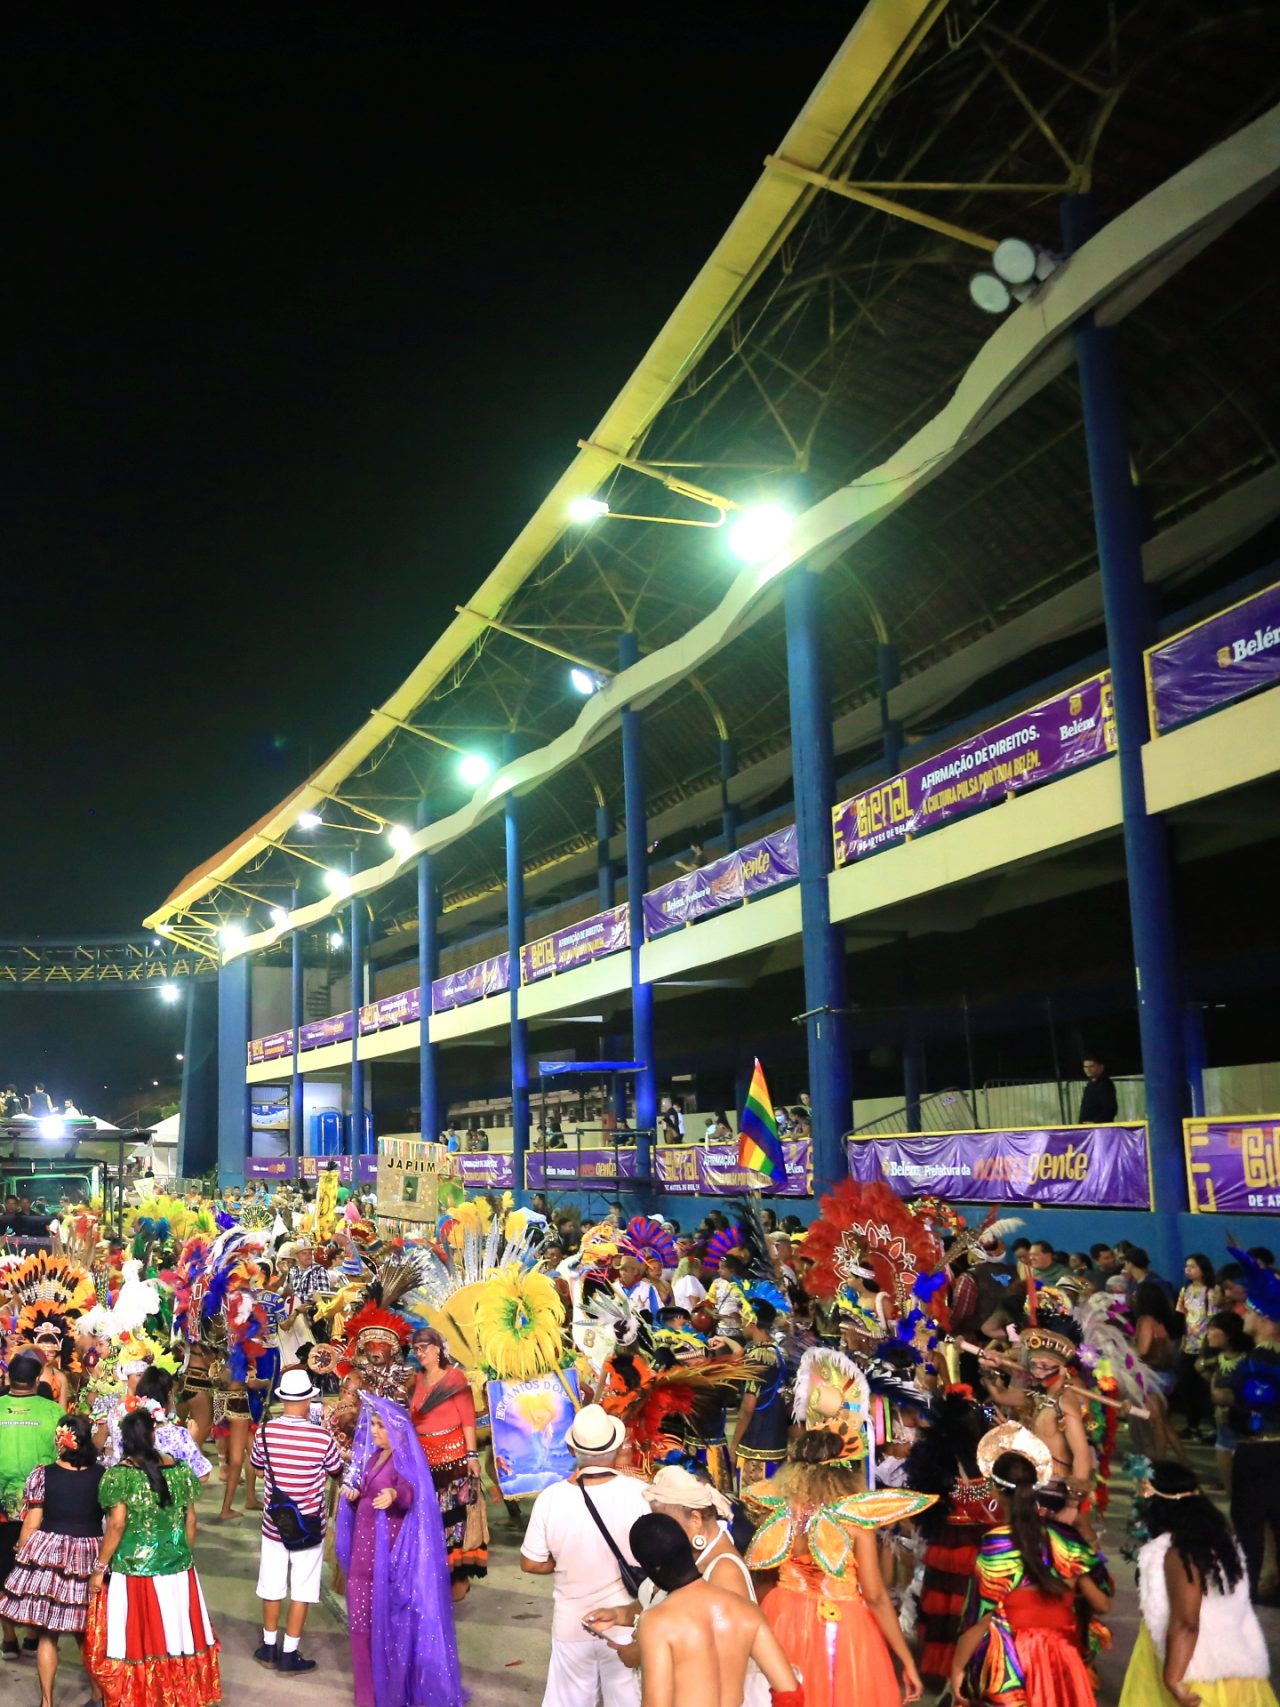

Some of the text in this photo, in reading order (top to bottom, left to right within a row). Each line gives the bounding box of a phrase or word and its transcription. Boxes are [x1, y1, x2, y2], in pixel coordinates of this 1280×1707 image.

[1059, 717, 1096, 740] Belém
[921, 754, 974, 791] AFIRMAÇÃO
[974, 748, 989, 766] DE
[987, 725, 1040, 759] DIREITOS.
[868, 832, 886, 848] ARTES
[890, 1160, 922, 1177] Belém
[923, 1162, 961, 1176] Prefeitura
[960, 1162, 971, 1176] da
[1027, 1144, 1089, 1184] gente
[1248, 1195, 1264, 1207] DE
[496, 1380, 540, 1420] ENCANTOS
